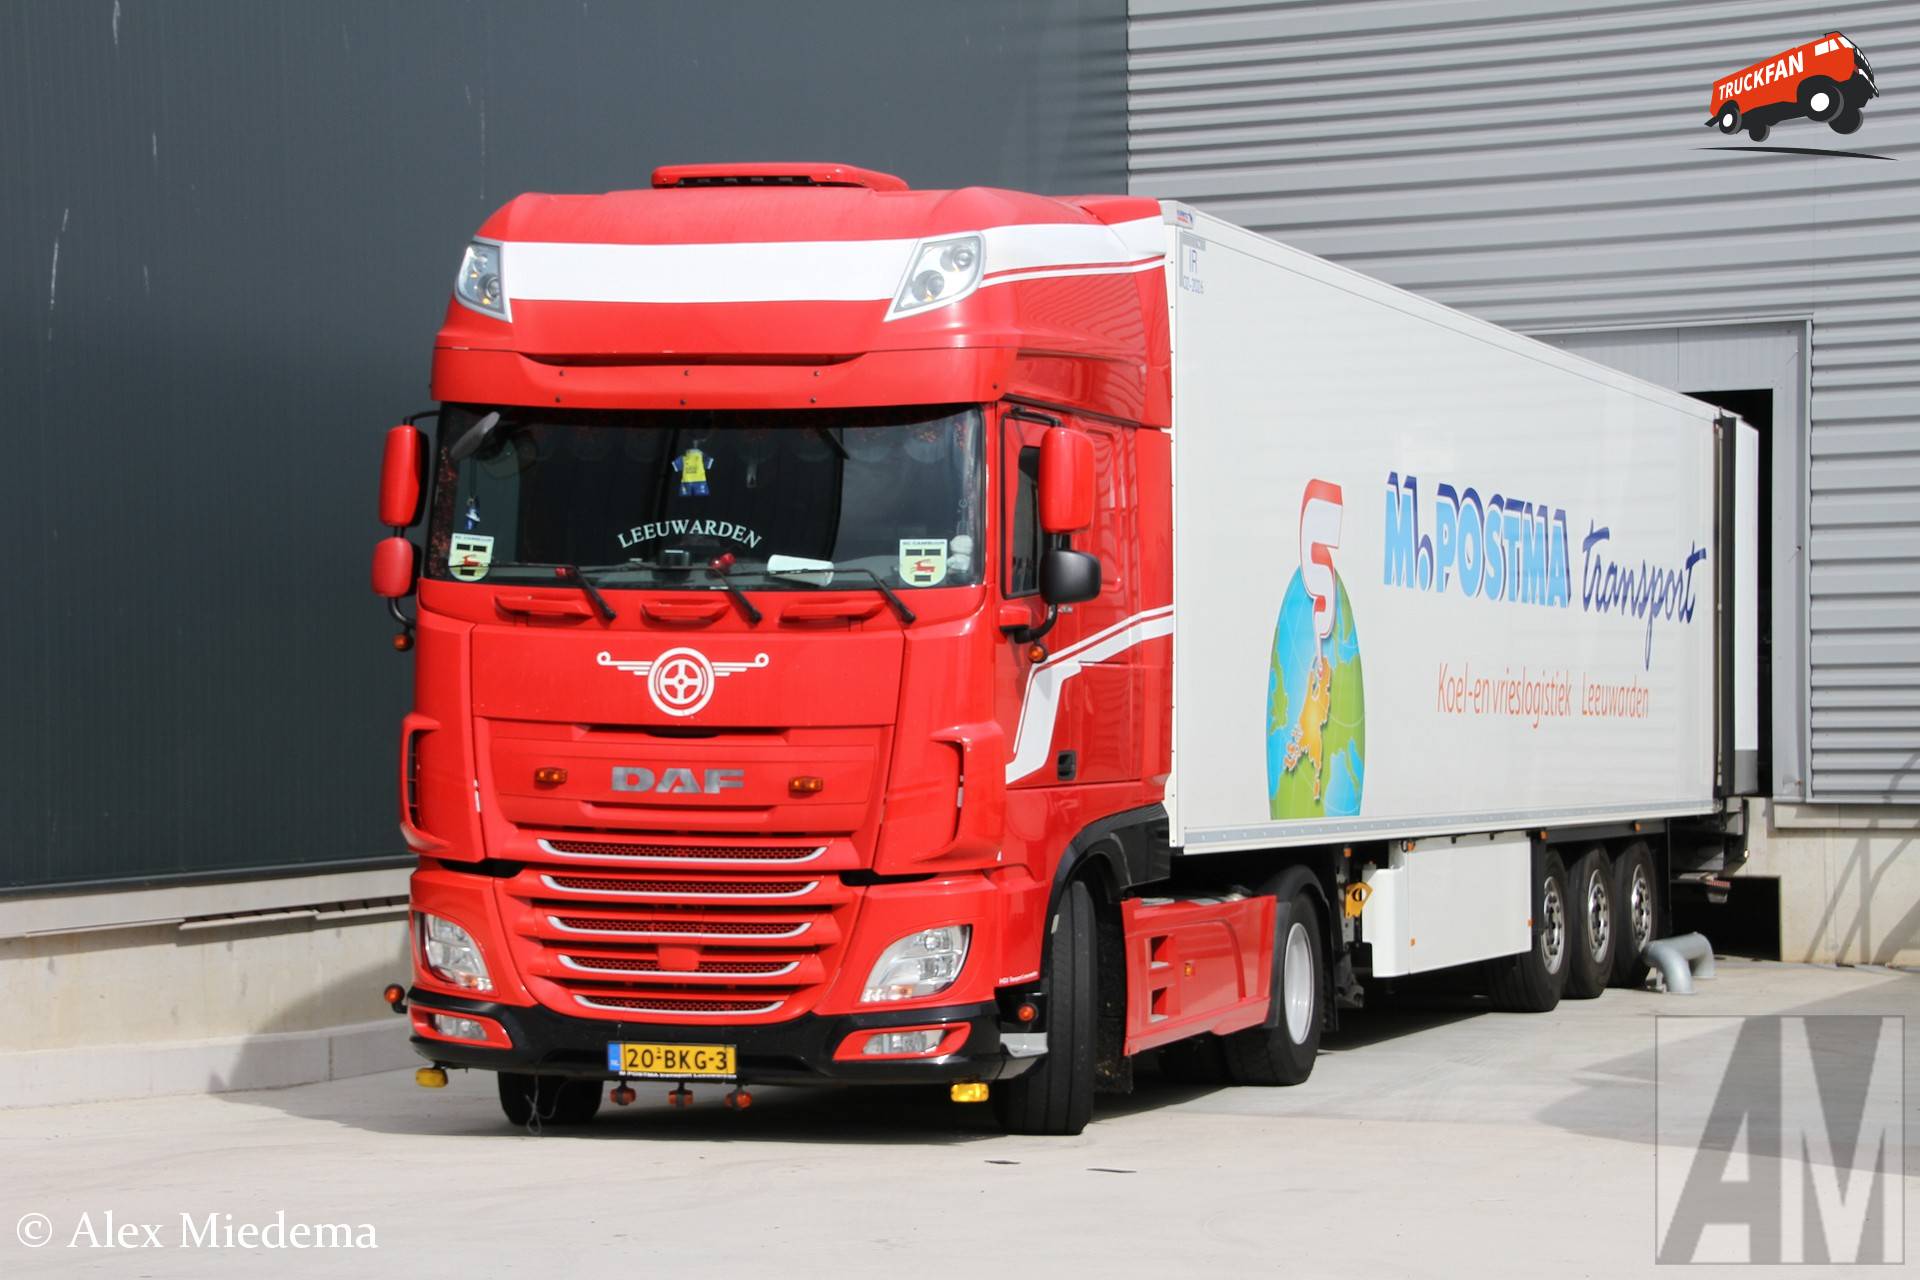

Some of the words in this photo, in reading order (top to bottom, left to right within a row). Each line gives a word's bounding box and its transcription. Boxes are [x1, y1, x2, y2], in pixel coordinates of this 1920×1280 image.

[617, 518, 763, 549] LEEUWARDEN
[1436, 483, 1571, 608] POSTMA
[1581, 671, 1649, 719] Leeuwarden
[610, 766, 745, 794] DAF
[628, 1048, 727, 1070] 20-BKG-3
